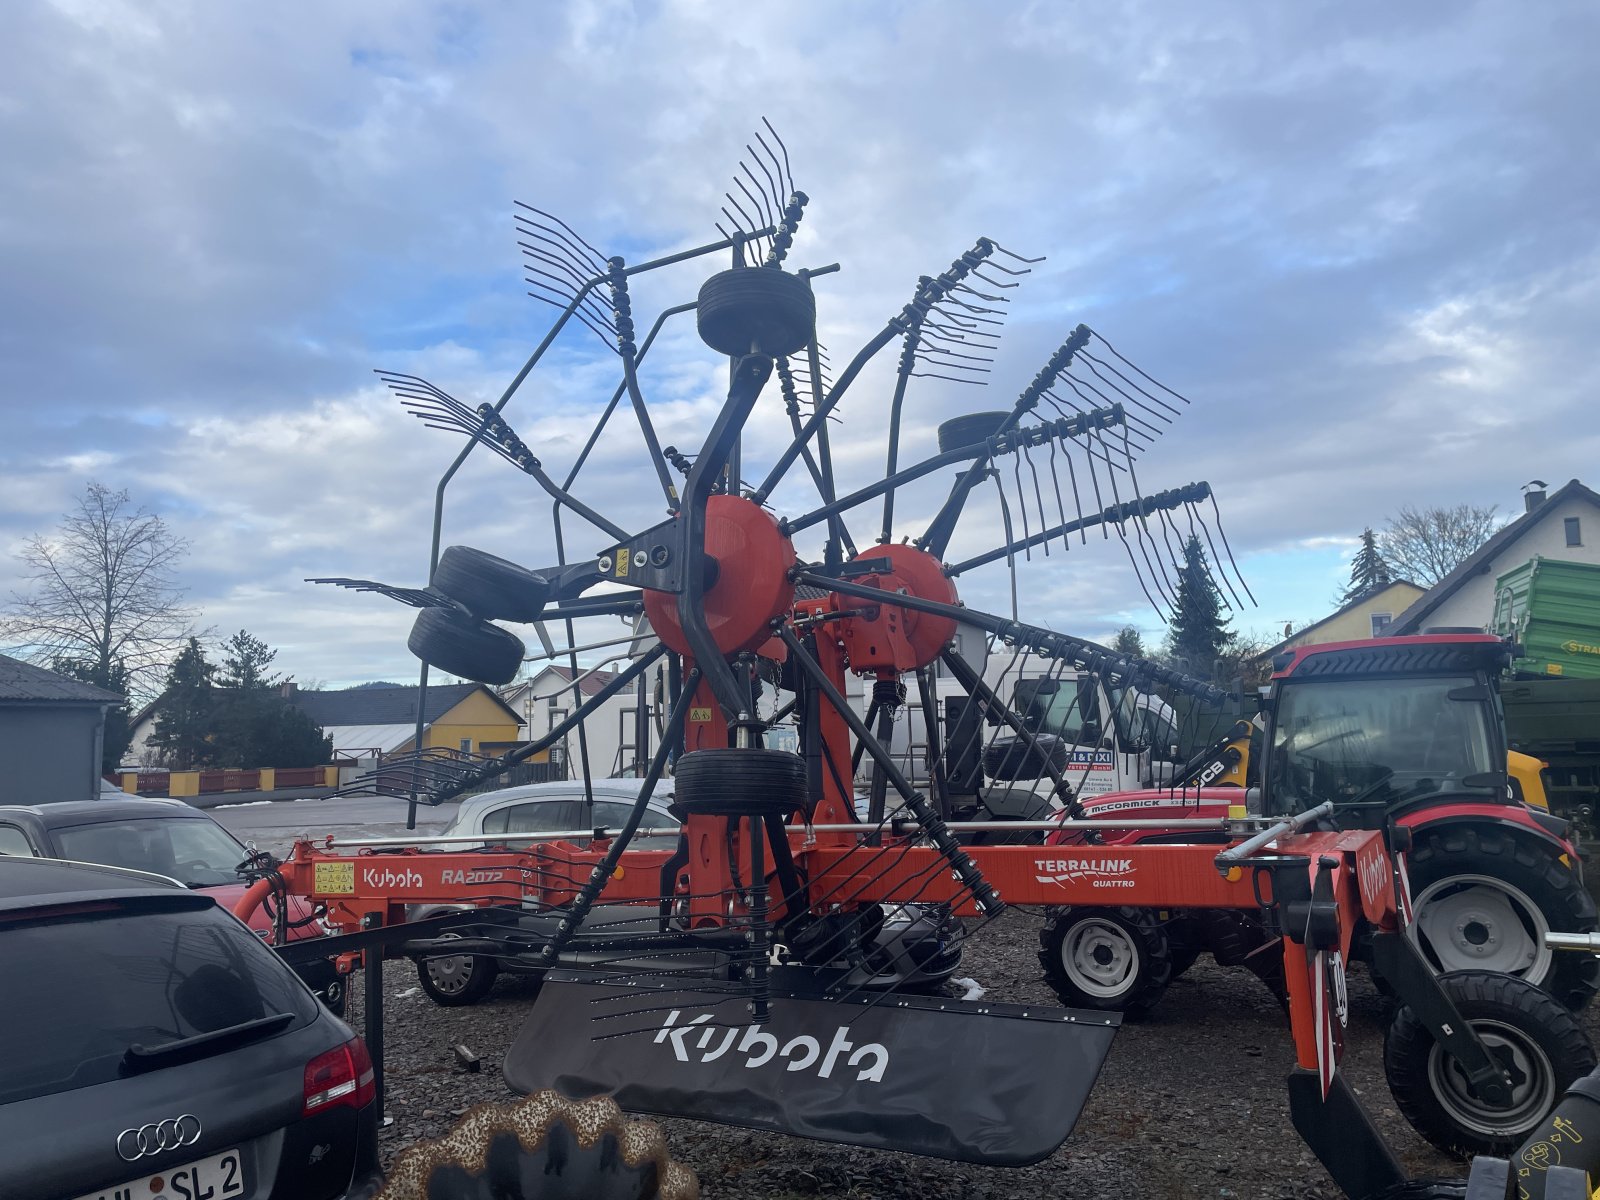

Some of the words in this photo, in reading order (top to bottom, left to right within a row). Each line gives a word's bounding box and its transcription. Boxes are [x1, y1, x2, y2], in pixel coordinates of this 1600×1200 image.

[1569, 643, 1600, 655] STRA
[1087, 753, 1110, 762] DIXI
[1034, 859, 1133, 872] TERRALINK
[363, 868, 423, 888] Kubota
[1360, 843, 1388, 905] Kubota
[1092, 880, 1136, 888] QUATTRO
[653, 1010, 889, 1083] Kubota
[220, 1156, 240, 1194] 2
